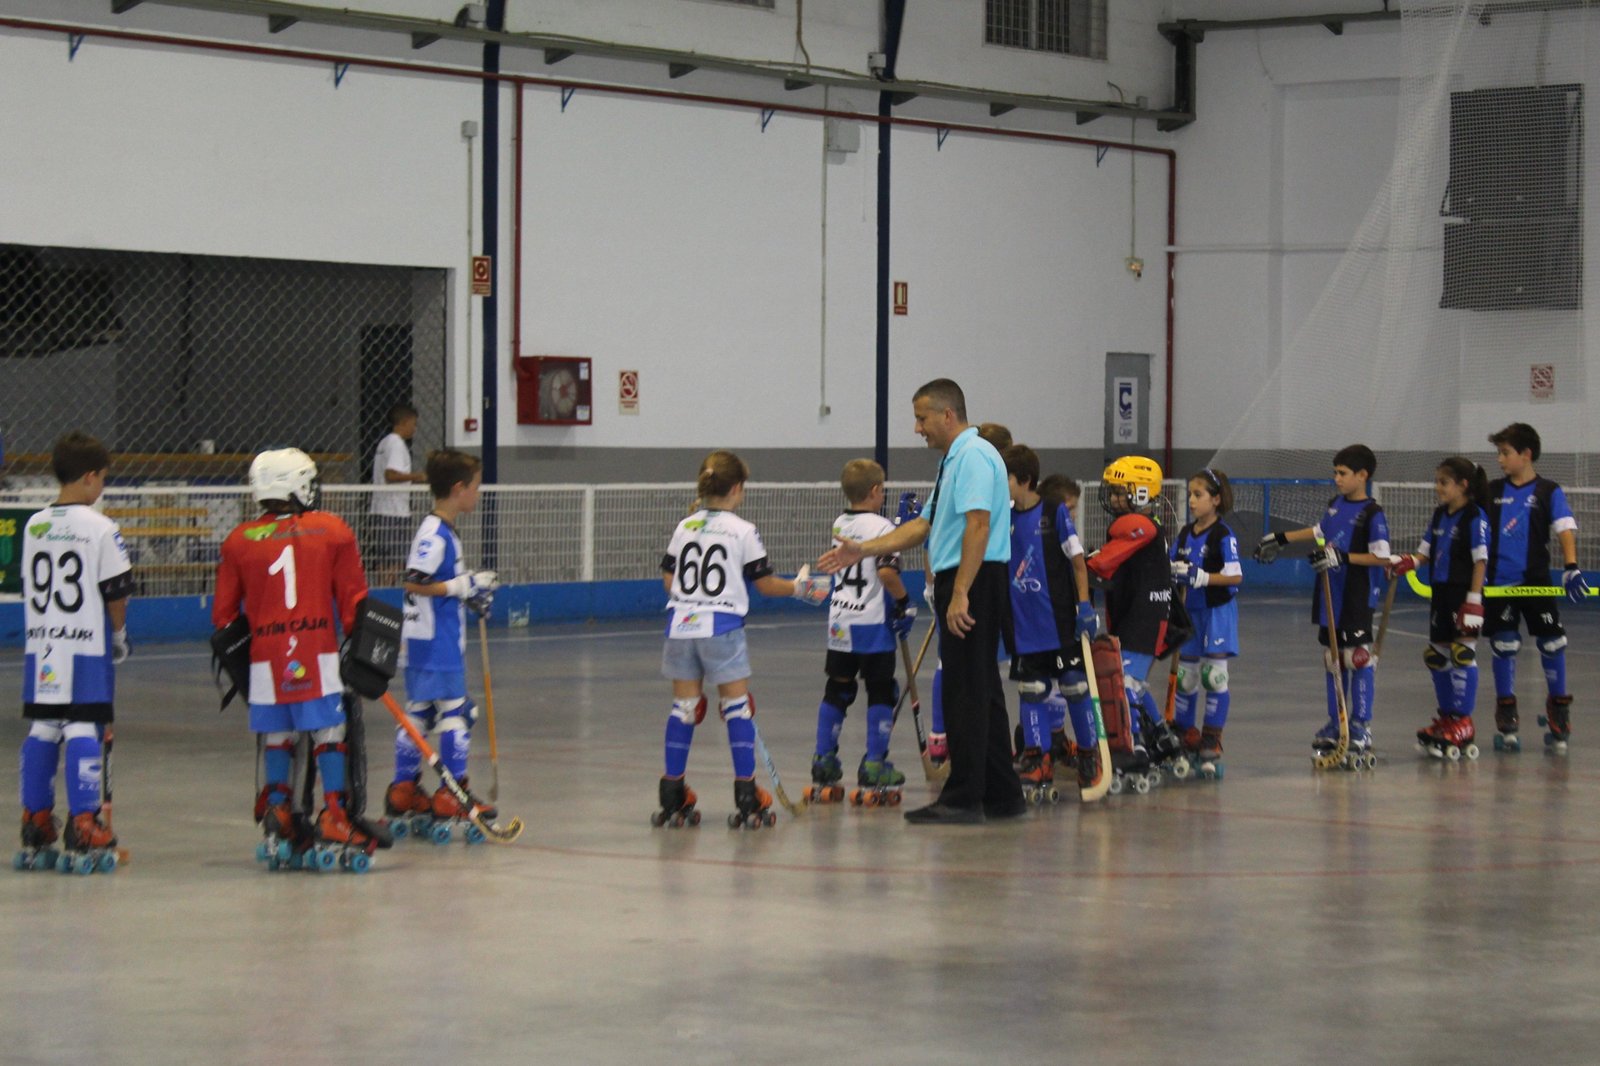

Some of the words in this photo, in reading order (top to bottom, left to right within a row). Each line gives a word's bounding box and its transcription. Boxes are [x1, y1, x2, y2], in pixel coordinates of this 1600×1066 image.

[32, 550, 84, 615] 93
[268, 544, 298, 610] 1
[678, 541, 727, 597] 66
[1504, 587, 1566, 597] COMPOSIT
